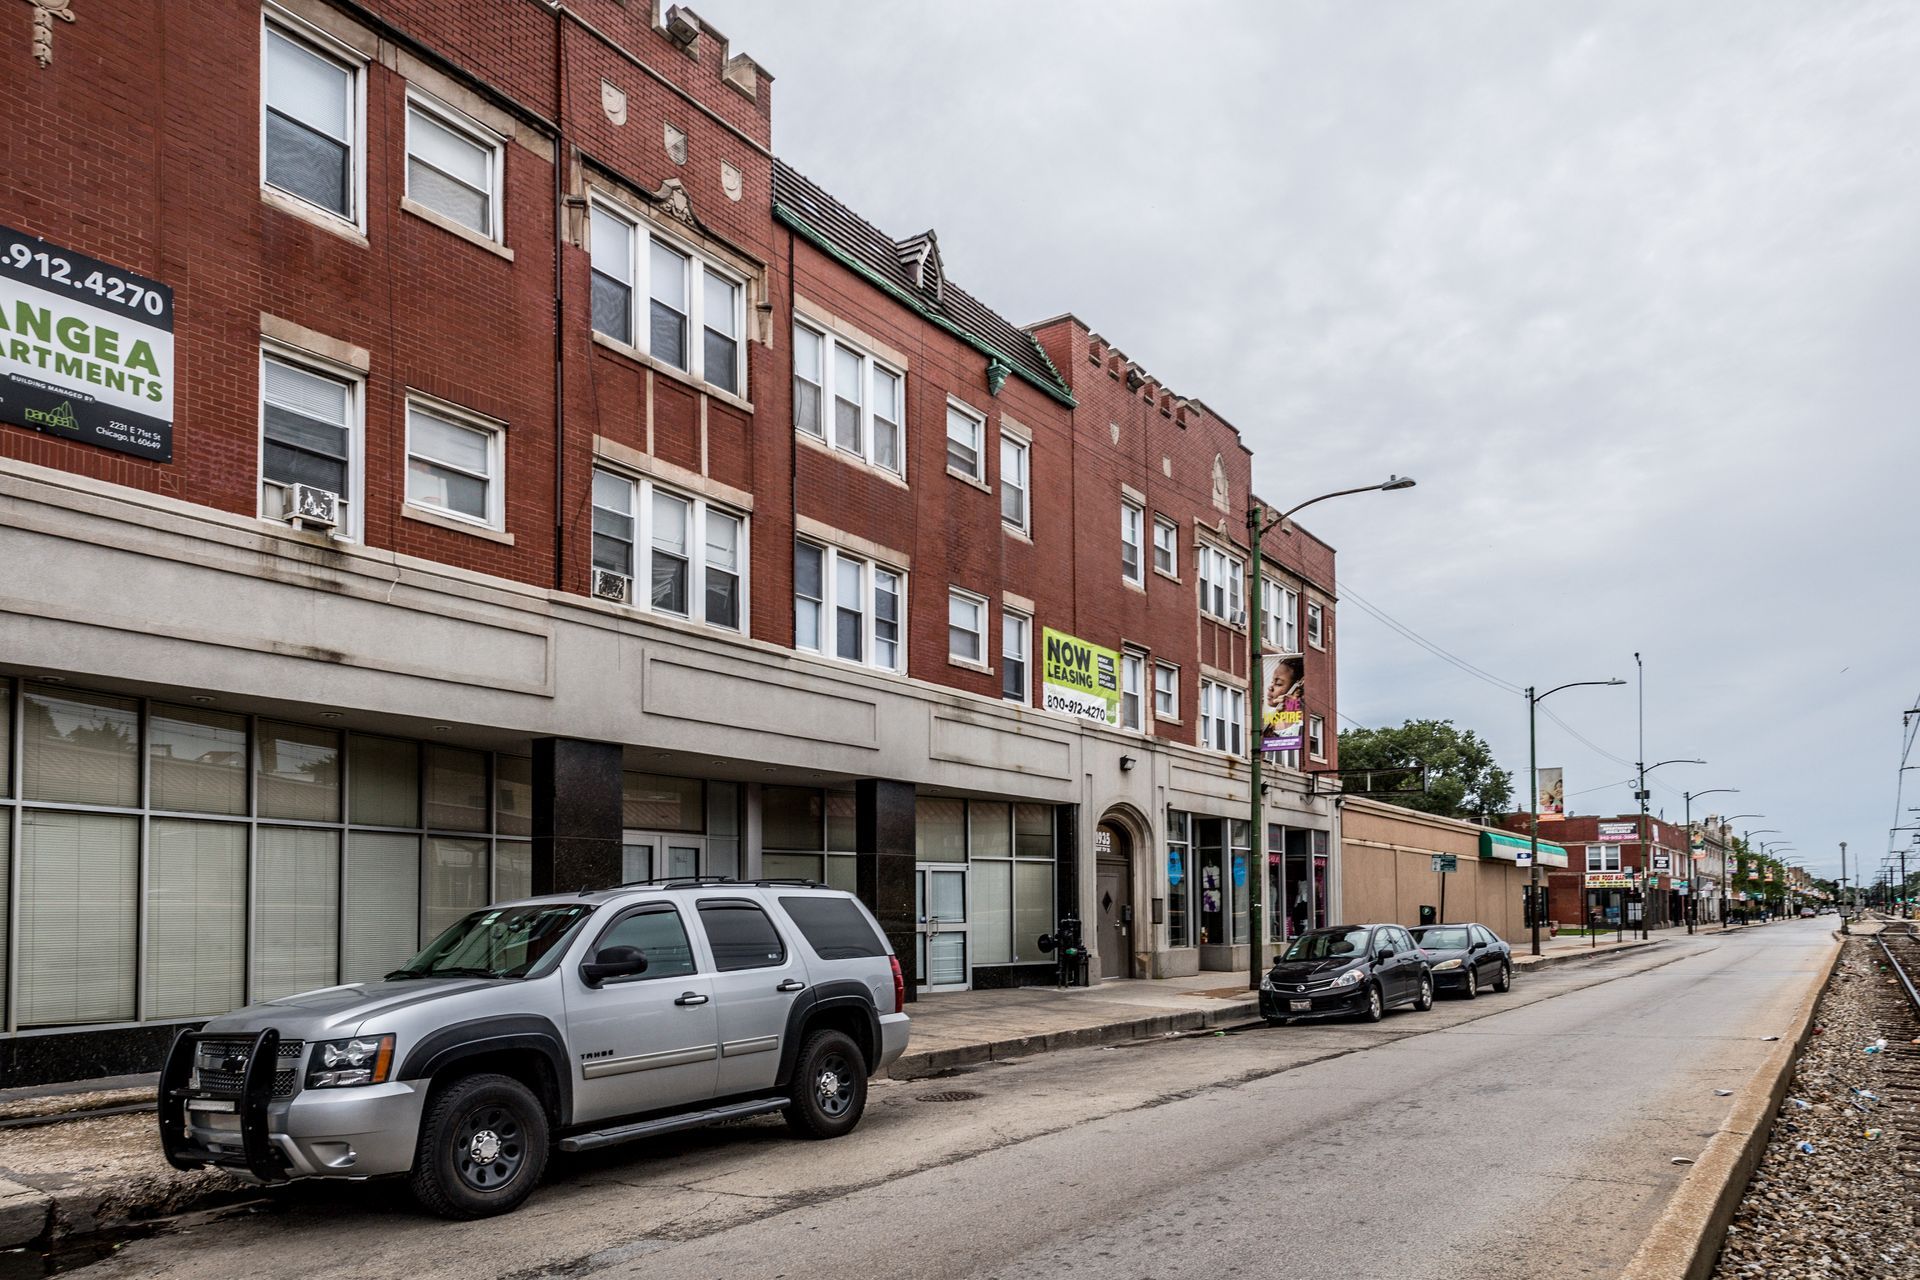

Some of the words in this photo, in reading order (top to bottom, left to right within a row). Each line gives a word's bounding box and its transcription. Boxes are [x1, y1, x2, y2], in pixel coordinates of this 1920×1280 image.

[0, 300, 161, 377] NGEA
[0, 339, 163, 402] RTMENTS
[11, 375, 46, 389] BUILDING
[48, 386, 83, 399] MANAGED
[25, 407, 70, 427] pangea
[96, 426, 129, 442] Chicago,
[130, 435, 137, 443] IL
[137, 438, 161, 449] 60649
[109, 420, 128, 431] 2231
[130, 426, 136, 434] E
[137, 428, 151, 439] 71st
[152, 432, 161, 441] St
[1047, 636, 1092, 673] NOW
[1047, 663, 1093, 689] LEASING
[1047, 694, 1105, 721] 800-912-4270
[580, 1049, 614, 1060] TAHOE
